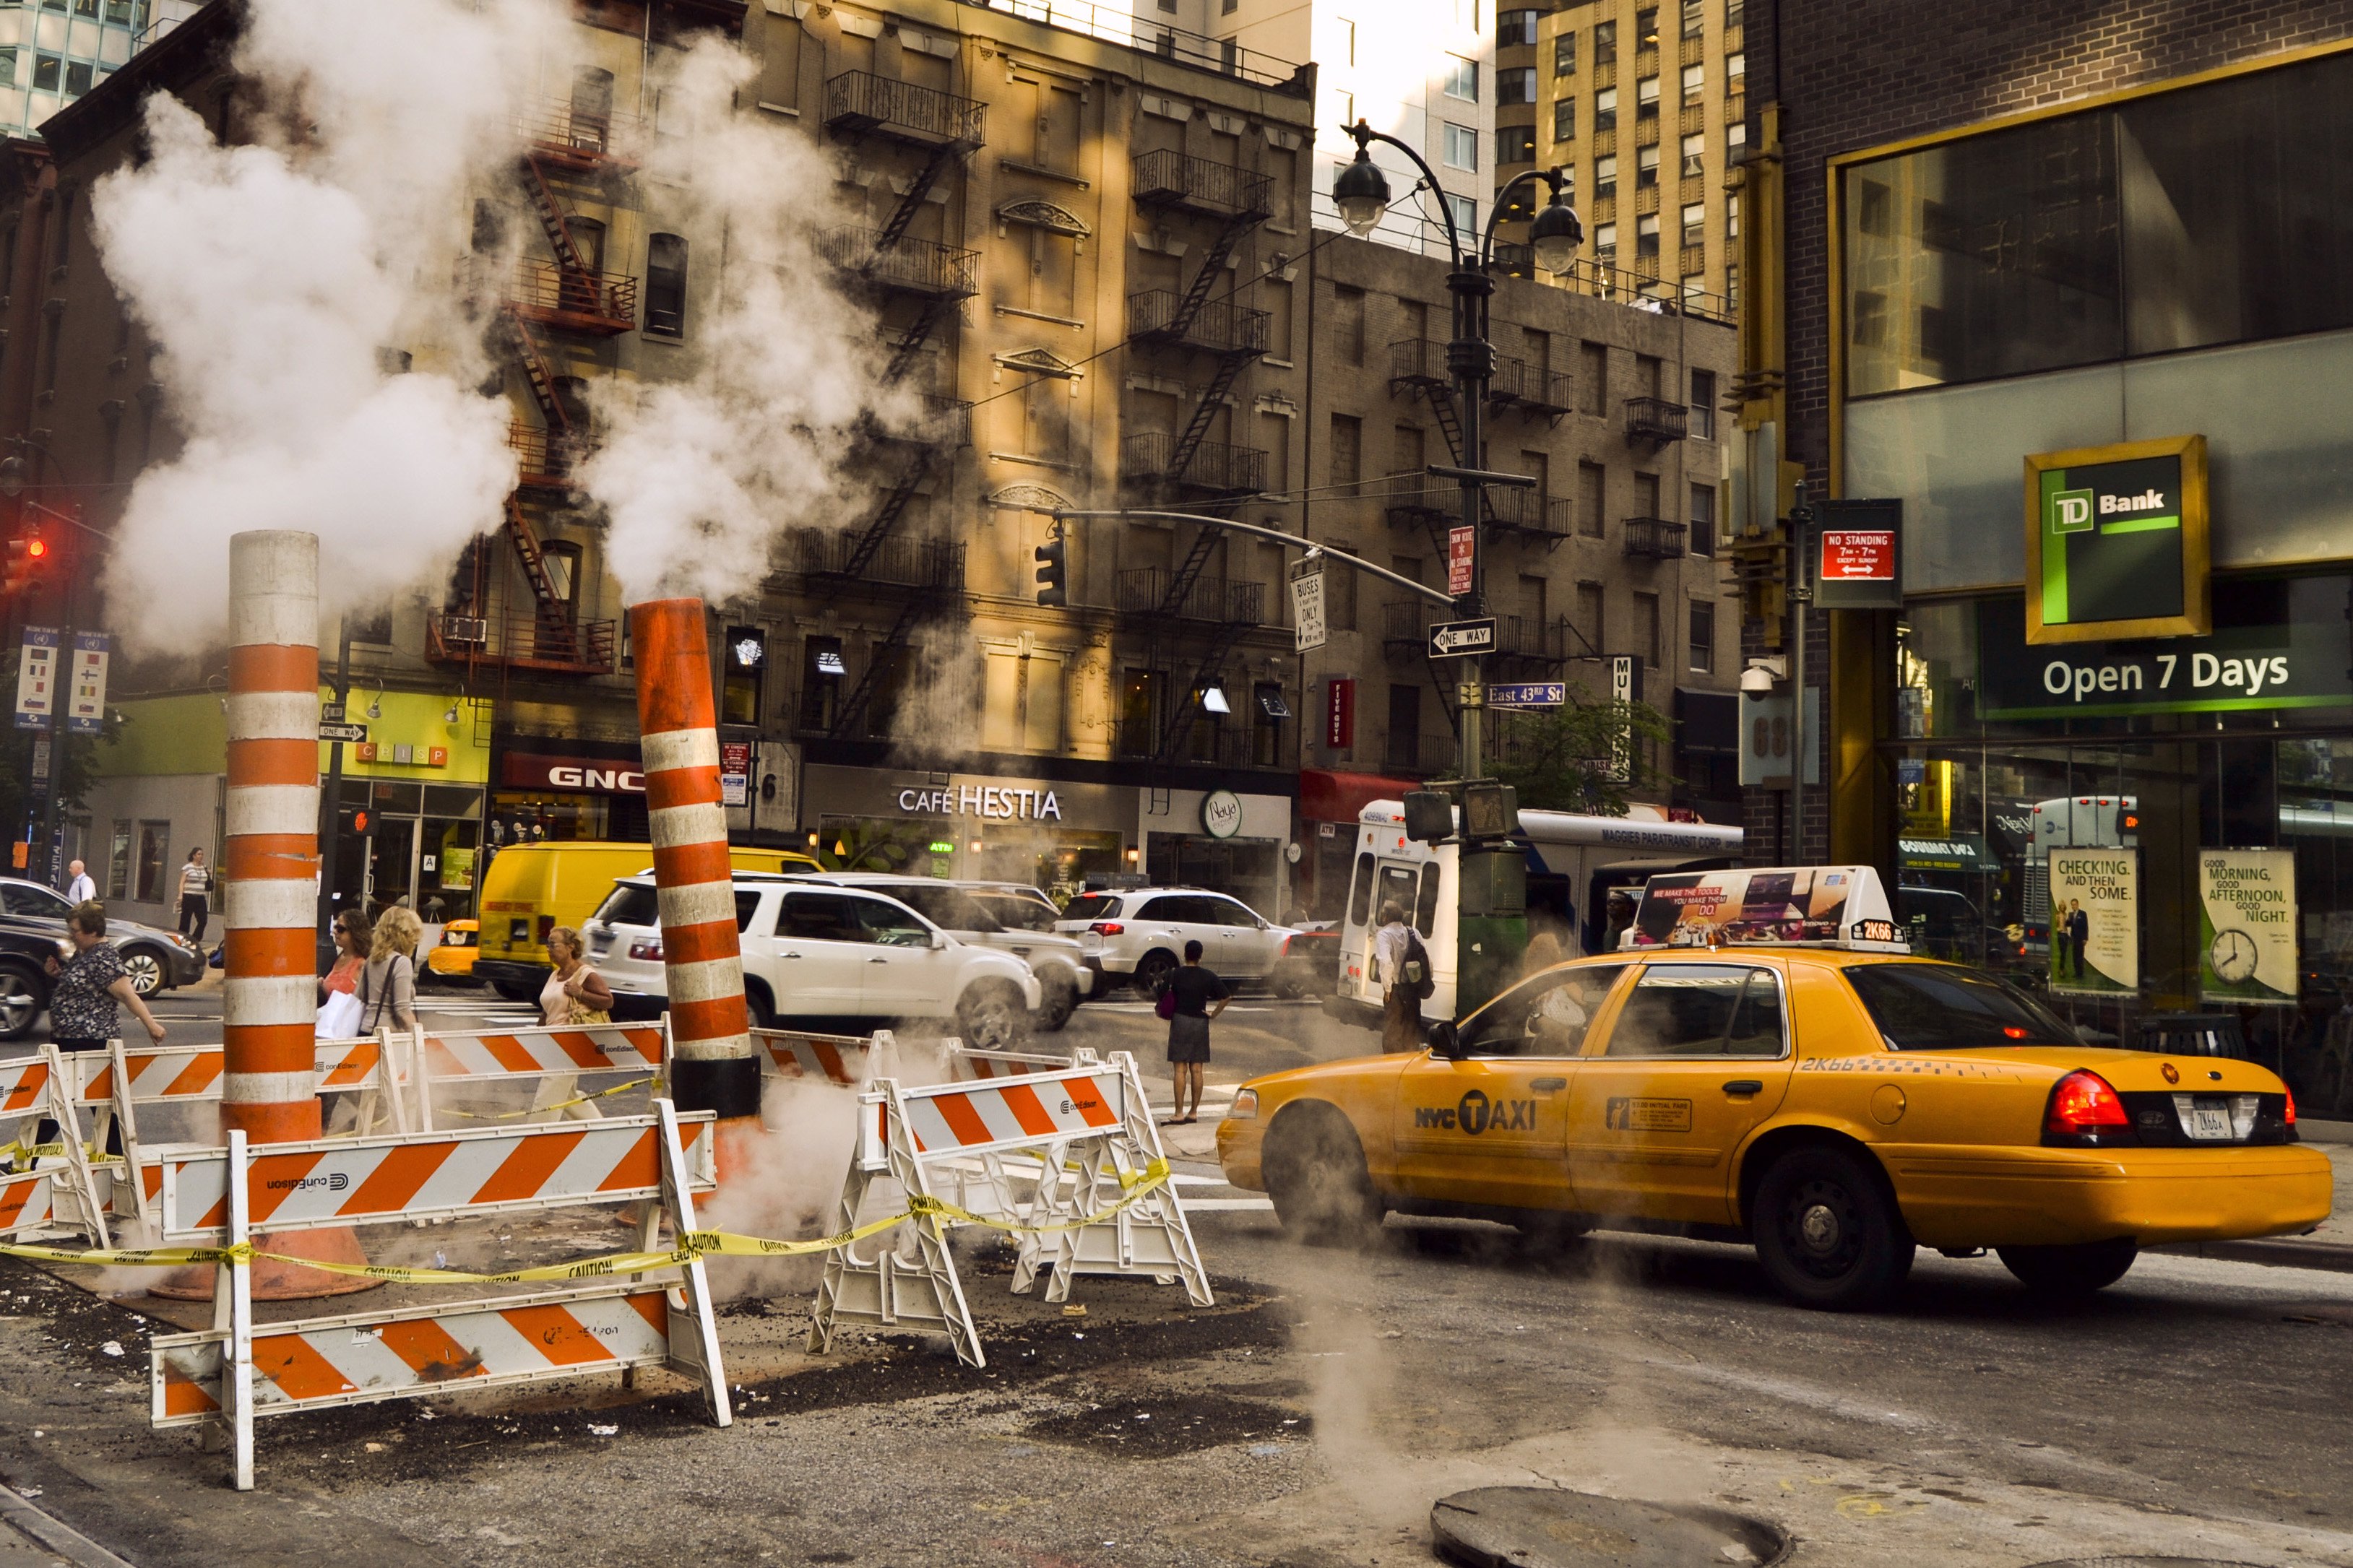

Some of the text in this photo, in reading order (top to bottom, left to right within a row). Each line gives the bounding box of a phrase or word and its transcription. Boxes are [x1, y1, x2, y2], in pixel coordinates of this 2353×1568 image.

[2056, 489, 2164, 524] TD Bank
[1829, 535, 1888, 545] NO STANDING
[1839, 547, 1854, 556] 7AM
[1861, 547, 1876, 556] 7PM
[1298, 579, 1318, 598] BUSES
[1302, 605, 1318, 622] ONLY
[1439, 630, 1487, 646] ONE WAY
[2044, 653, 2289, 702] Open 7 Days
[1488, 688, 1516, 702] East
[1547, 686, 1562, 701] St
[324, 727, 338, 736] ONE
[363, 746, 442, 761] CRISP
[548, 766, 647, 791] GNC
[899, 785, 1062, 820] CAFÉ HESTIA
[1209, 801, 1237, 821] Naya
[1321, 826, 1334, 834] ATM
[929, 841, 954, 852] ATM
[1602, 829, 1641, 845] MAGGIES
[1641, 832, 1697, 849] PARATRANSIT
[1698, 836, 1722, 849] CORP.
[426, 857, 433, 867] A
[2058, 859, 2130, 875] CHECKING.
[2204, 859, 2226, 868] GOOD
[2065, 875, 2115, 886] AND THEN
[2209, 868, 2271, 883] MORNING,
[2216, 880, 2240, 889] GOOD
[2090, 886, 2132, 900] SOME.
[2209, 889, 2287, 904] AFTERNOON,
[2245, 911, 2289, 923] NIGHT.
[1864, 921, 1892, 941] 2K66
[1801, 1057, 1855, 1071] 2K66
[1415, 1099, 1537, 1131] NYC TAXI
[267, 1177, 327, 1190] conEdison
[685, 1234, 722, 1251] CAUTION
